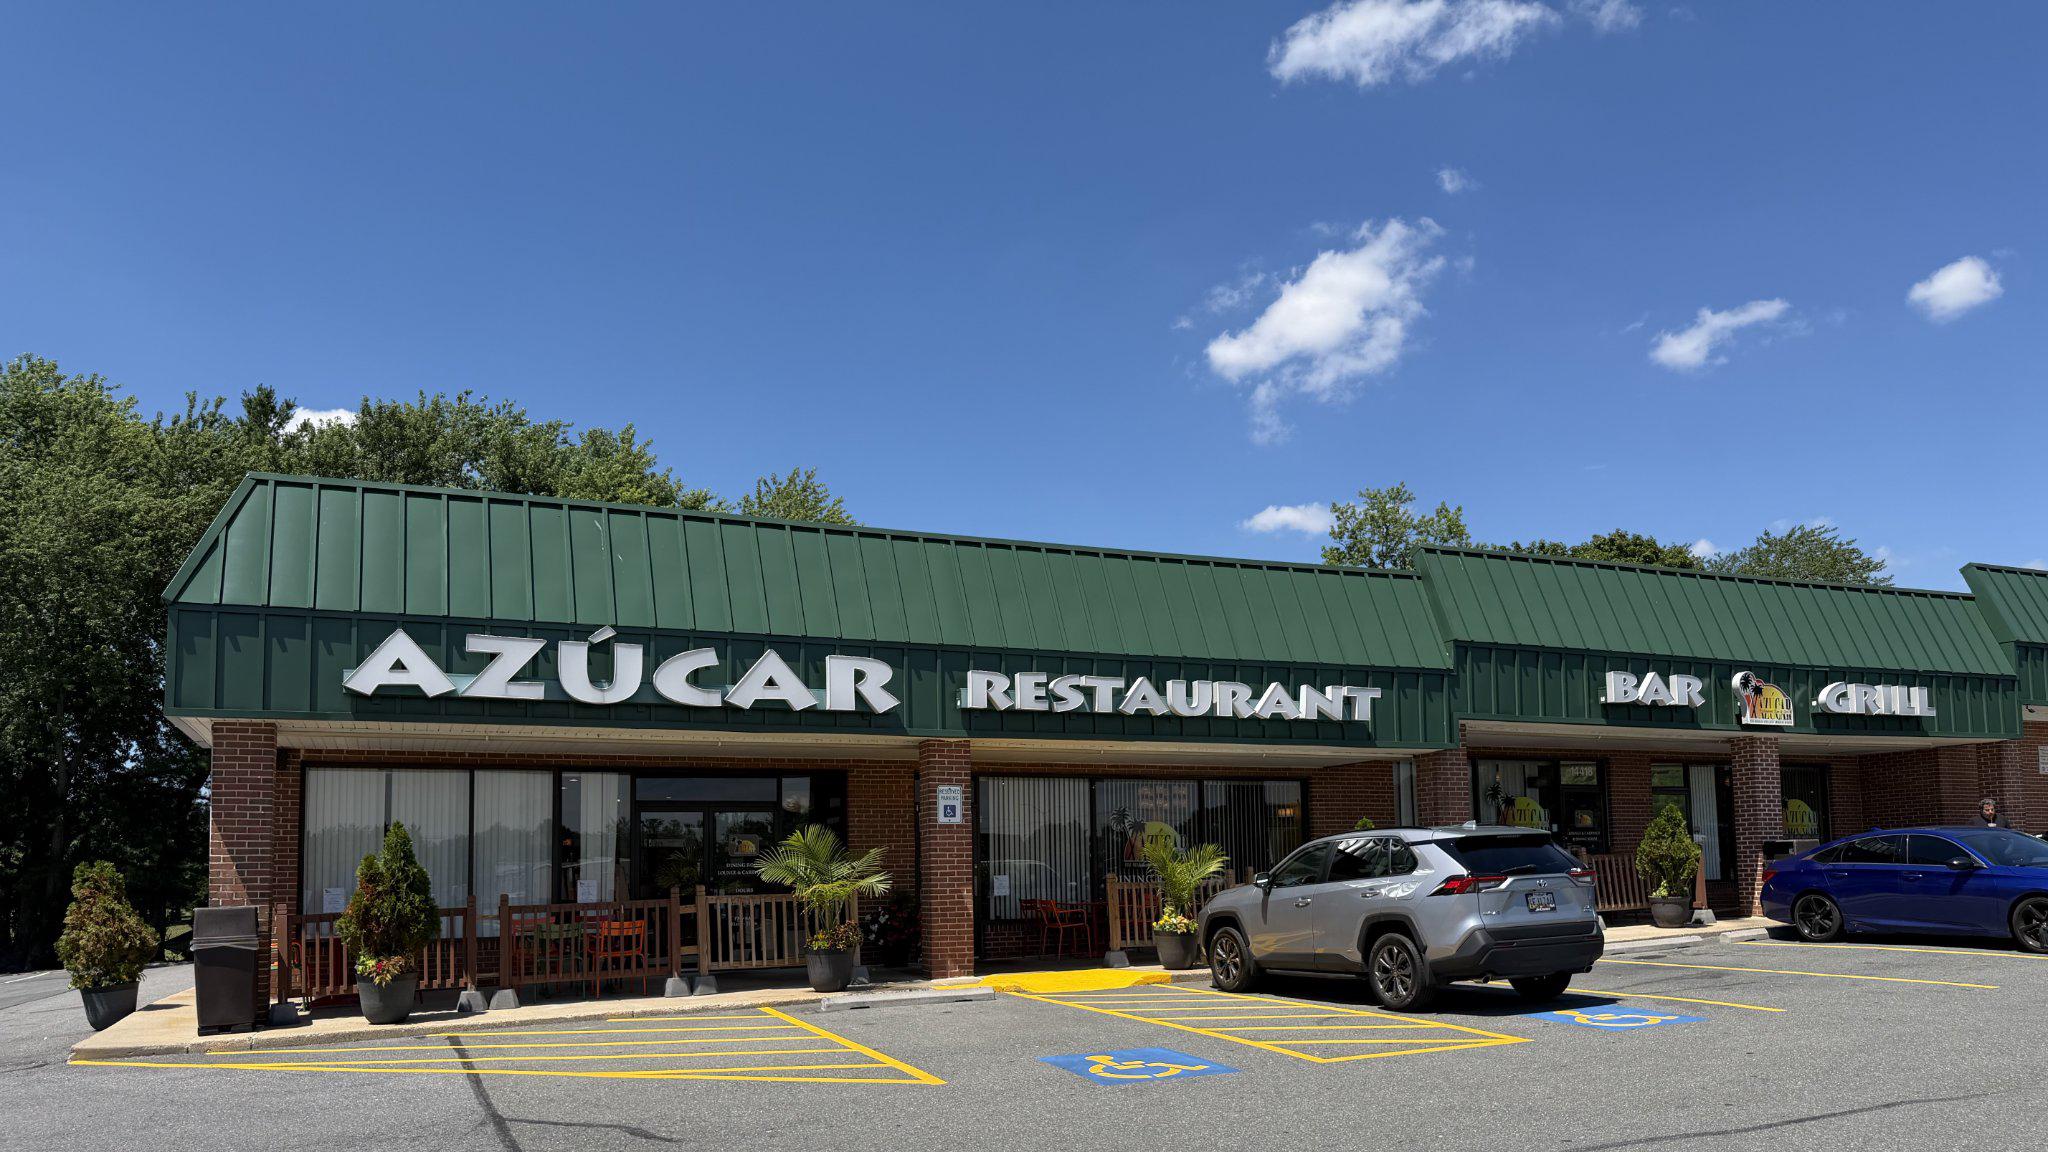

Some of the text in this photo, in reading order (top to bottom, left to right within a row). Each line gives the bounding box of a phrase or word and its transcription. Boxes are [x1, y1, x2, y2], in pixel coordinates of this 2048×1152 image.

[341, 624, 901, 714] AZÚCAR
[966, 670, 1382, 721] RESTAURANT
[1604, 670, 1706, 708] BAR
[1817, 681, 1936, 717] GRILL
[1570, 765, 1593, 777] 14418
